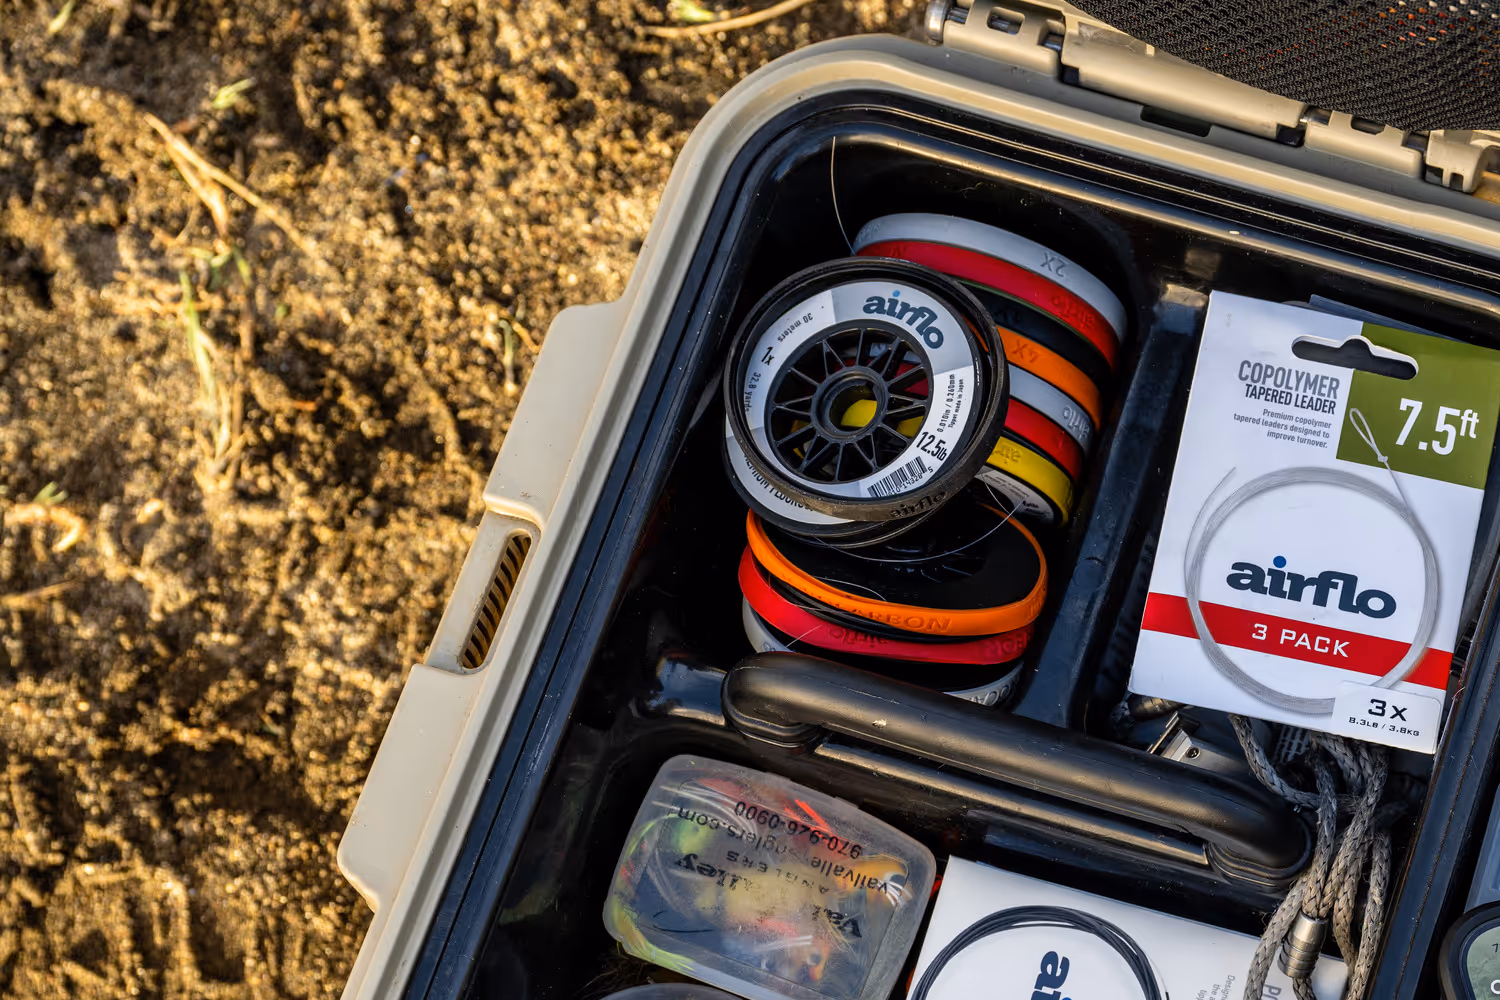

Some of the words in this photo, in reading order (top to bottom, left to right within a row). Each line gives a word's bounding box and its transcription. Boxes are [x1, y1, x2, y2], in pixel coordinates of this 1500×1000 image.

[777, 320, 802, 342] meters
[802, 312, 814, 324] 30
[862, 290, 944, 350] airflo
[748, 371, 762, 389] 32.8
[1238, 359, 1340, 400] COPOLYMER
[1244, 383, 1293, 406] TAPERED
[1294, 393, 1337, 415] LEADER
[1233, 413, 1261, 425] tapered
[1261, 418, 1288, 431] leaders
[1289, 424, 1324, 438] designed
[1322, 430, 1330, 439] to
[1262, 408, 1294, 421] Premium
[1294, 414, 1332, 429] copolymer
[915, 431, 948, 462] 12.5lb
[1266, 430, 1295, 443] improve
[1296, 435, 1328, 449] turnover.
[1225, 555, 1398, 620] airflo
[1251, 623, 1269, 641] 3
[1280, 629, 1350, 658] PACK
